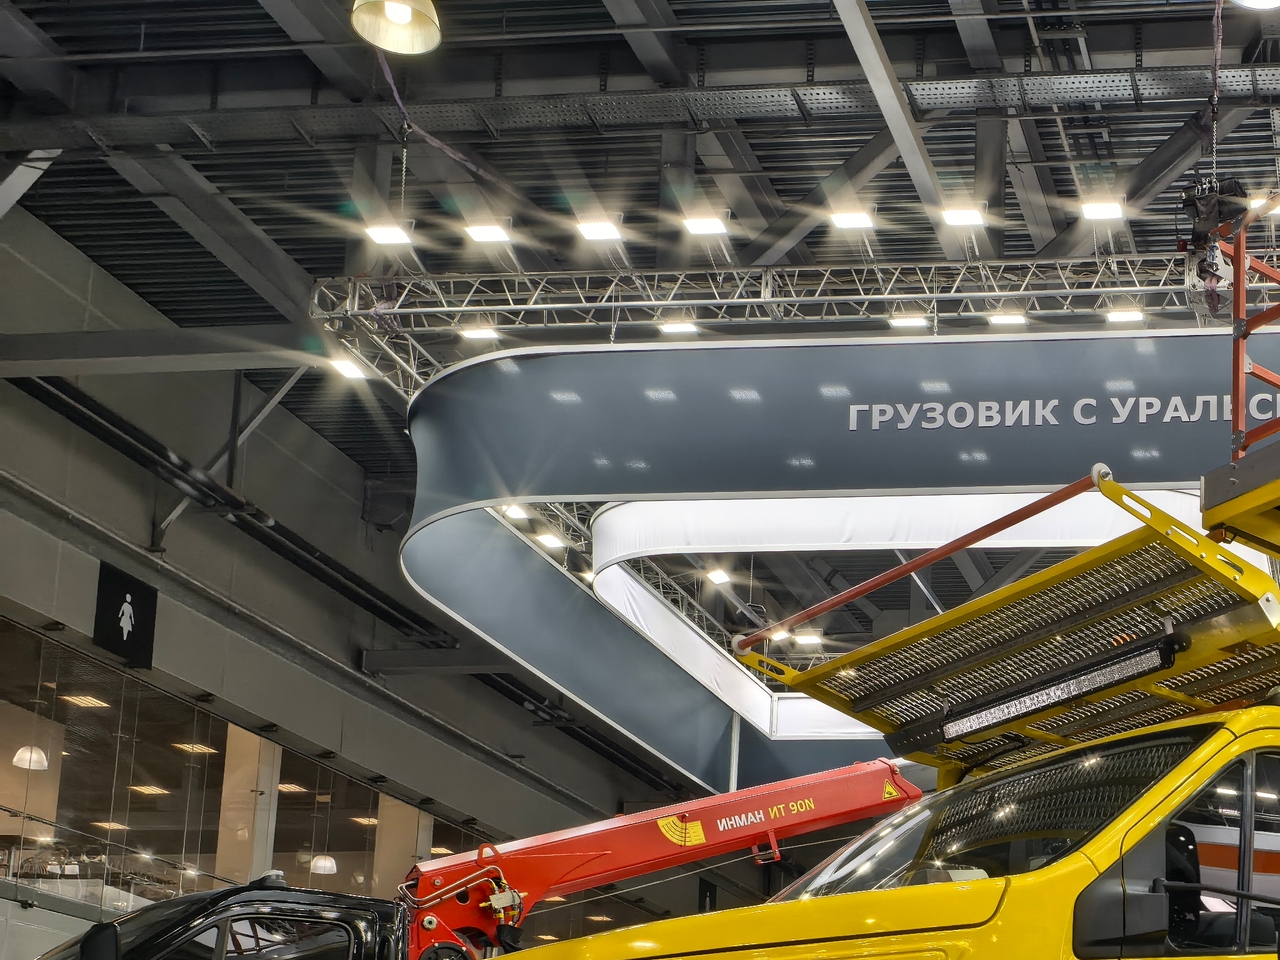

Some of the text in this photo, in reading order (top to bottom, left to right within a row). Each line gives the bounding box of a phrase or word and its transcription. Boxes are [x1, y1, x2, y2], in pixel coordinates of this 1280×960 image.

[848, 399, 1060, 431] ГРУЗОВИК
[1072, 397, 1098, 425] С
[716, 809, 765, 832] ИНМАН
[768, 803, 786, 820] ИТ
[789, 797, 816, 814] 90N
